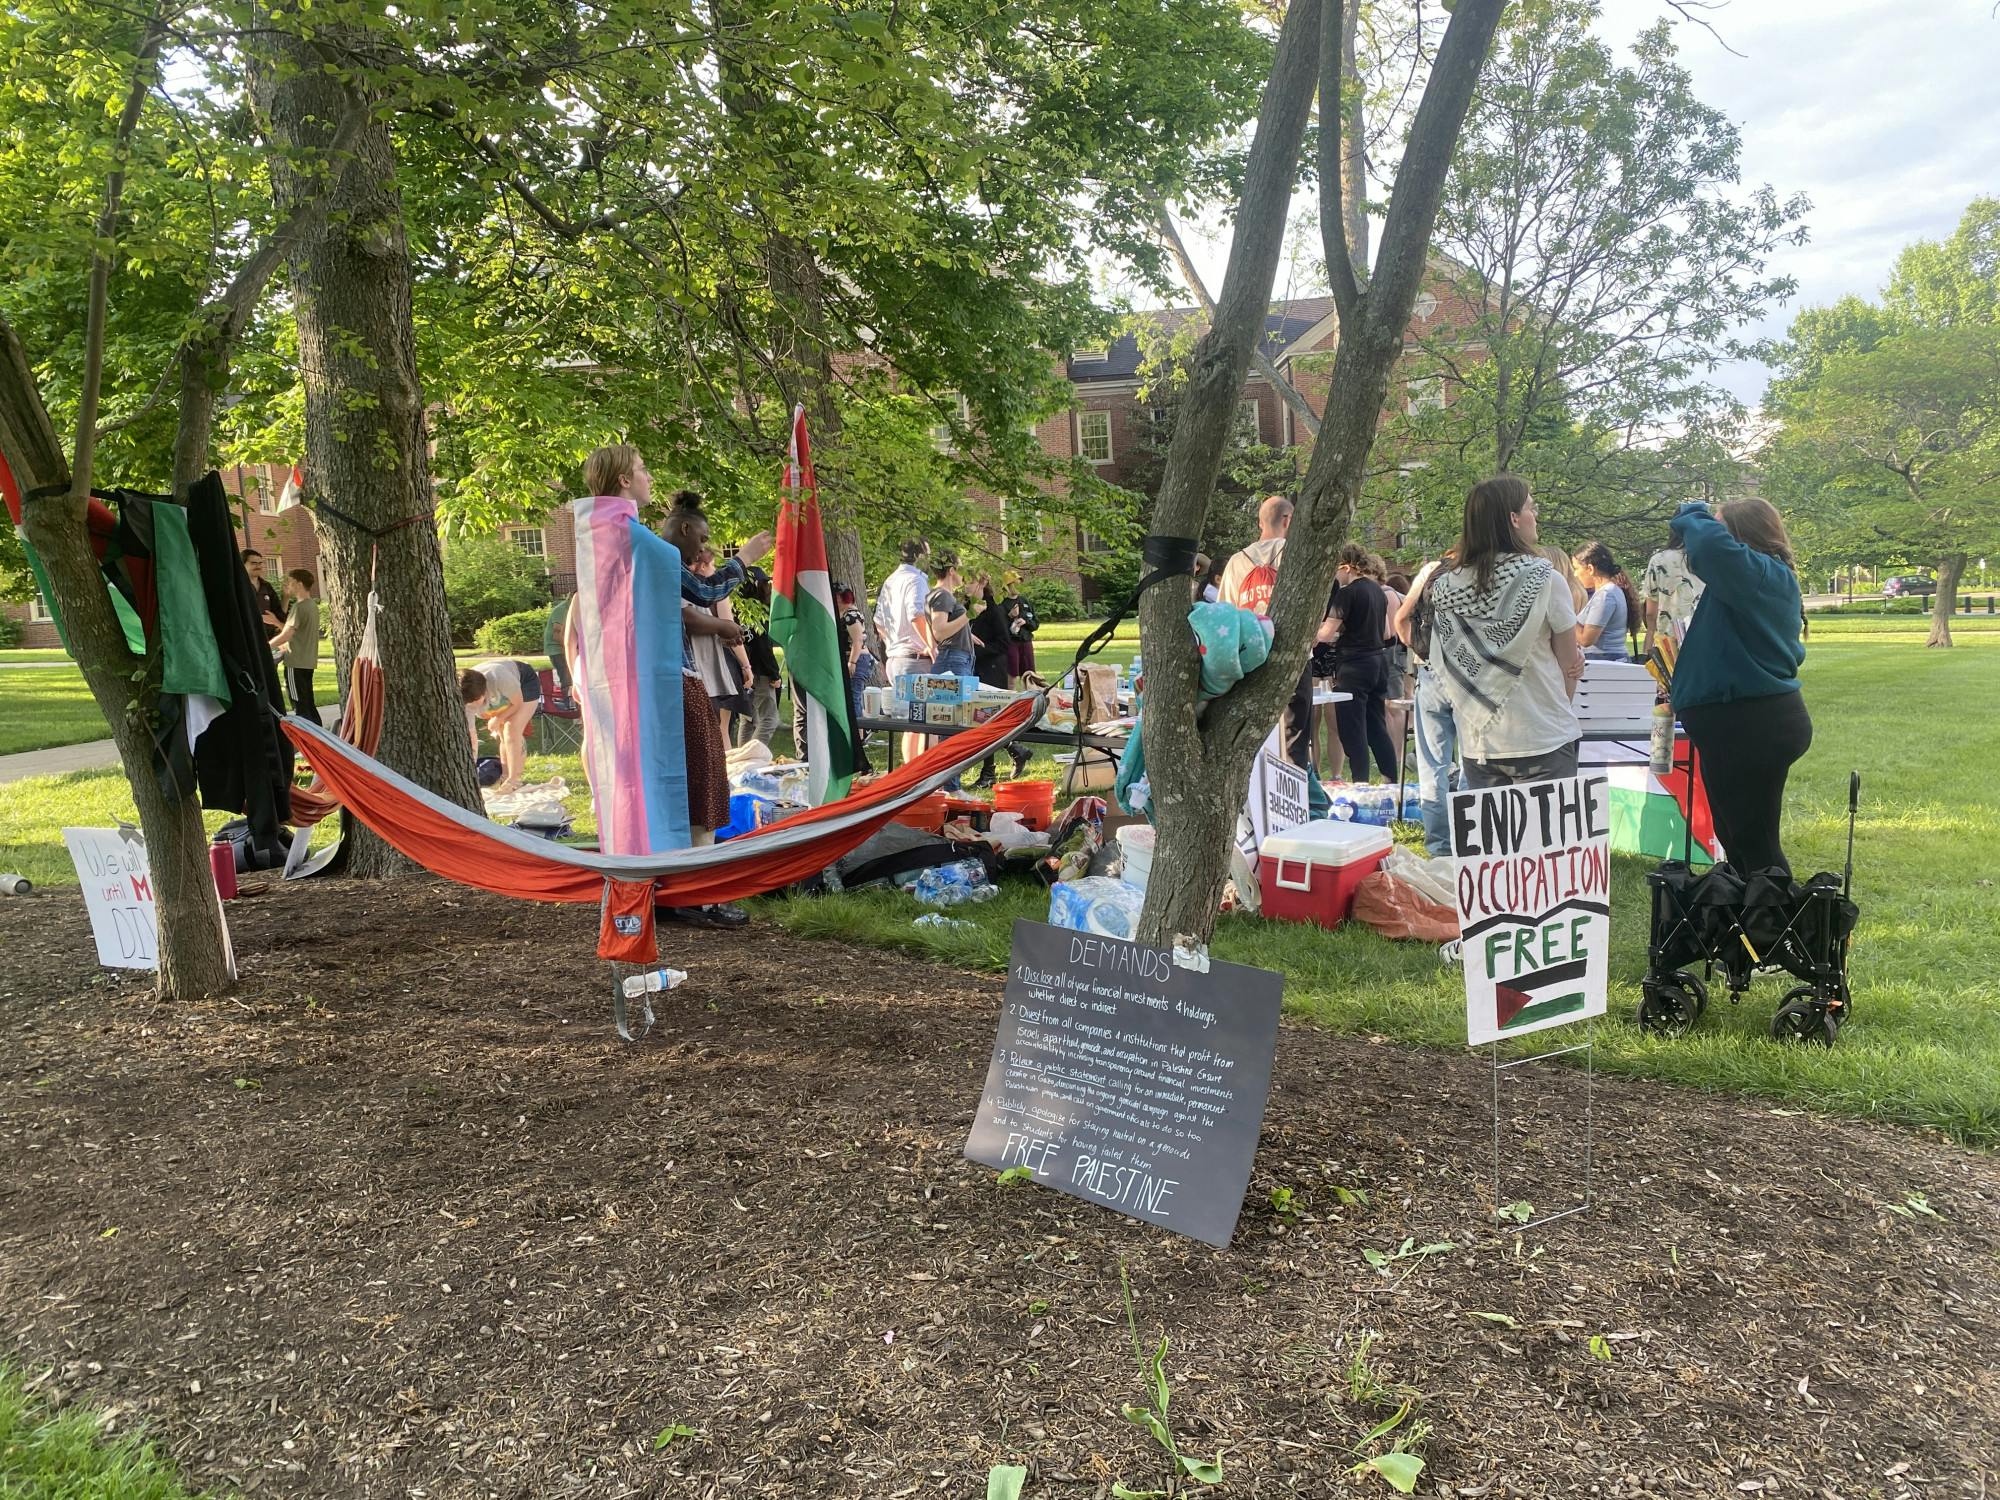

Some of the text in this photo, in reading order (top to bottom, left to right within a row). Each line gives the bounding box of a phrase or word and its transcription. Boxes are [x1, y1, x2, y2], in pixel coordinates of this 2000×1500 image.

[1269, 791, 1308, 825] CEASEFIRE
[1453, 776, 1610, 857] END THE
[79, 839, 142, 877] We will
[102, 881, 127, 902] until
[1458, 842, 1609, 921] OCCUPATION
[1070, 936, 1170, 982] DEMANDS
[1485, 915, 1592, 979] FREE
[1023, 966, 1052, 986] Disclose
[1054, 971, 1066, 987] all
[1067, 975, 1075, 989] of
[1074, 981, 1090, 995] your
[1092, 977, 1122, 999] financial
[1123, 989, 1168, 1010] investments
[1028, 987, 1055, 1002] whether
[1059, 992, 1077, 1006] direct
[1079, 1001, 1088, 1010] or
[1018, 1004, 1041, 1020] Divest
[1041, 1009, 1059, 1024] from
[1061, 1016, 1072, 1028] all
[1074, 1021, 1111, 1039] companies
[1122, 1033, 1167, 1052] institutions
[1170, 1043, 1185, 1057] that
[1187, 1048, 1211, 1063] profit
[1212, 1052, 1233, 1067] from
[1102, 1046, 1115, 1057] and
[1150, 1060, 1158, 1069] in
[1196, 1068, 1222, 1083] Ensure
[1133, 1067, 1155, 1079] around
[1157, 1071, 1185, 1088] financial
[1042, 1062, 1065, 1077] public
[1069, 1068, 1106, 1084] statement
[1108, 1078, 1132, 1096] calling
[1134, 1082, 1144, 1093] for
[1143, 1088, 1153, 1097] an
[1186, 1100, 1225, 1118] permanent
[992, 1115, 1007, 1125] and
[1009, 1117, 1017, 1127] to
[1022, 1122, 1053, 1139] students
[1057, 1130, 1067, 1143] for
[1071, 1135, 1097, 1155] having
[1100, 1143, 1123, 1160] failed
[995, 1095, 1026, 1116] Publicly
[1030, 1106, 1065, 1122] apologize
[1068, 1112, 1080, 1126] for
[1082, 1119, 1109, 1140] staying
[1112, 1128, 1135, 1142] neutral
[1137, 1137, 1146, 1145] on
[1151, 1143, 1190, 1159] genocide
[1085, 1101, 1094, 1109] on
[1151, 1120, 1160, 1130] to
[1161, 1124, 1172, 1134] do
[1174, 1128, 1184, 1138] so
[1173, 1111, 1196, 1122] against
[1201, 1114, 1213, 1127] the
[1001, 1132, 1178, 1214] FREE PALESTINE
